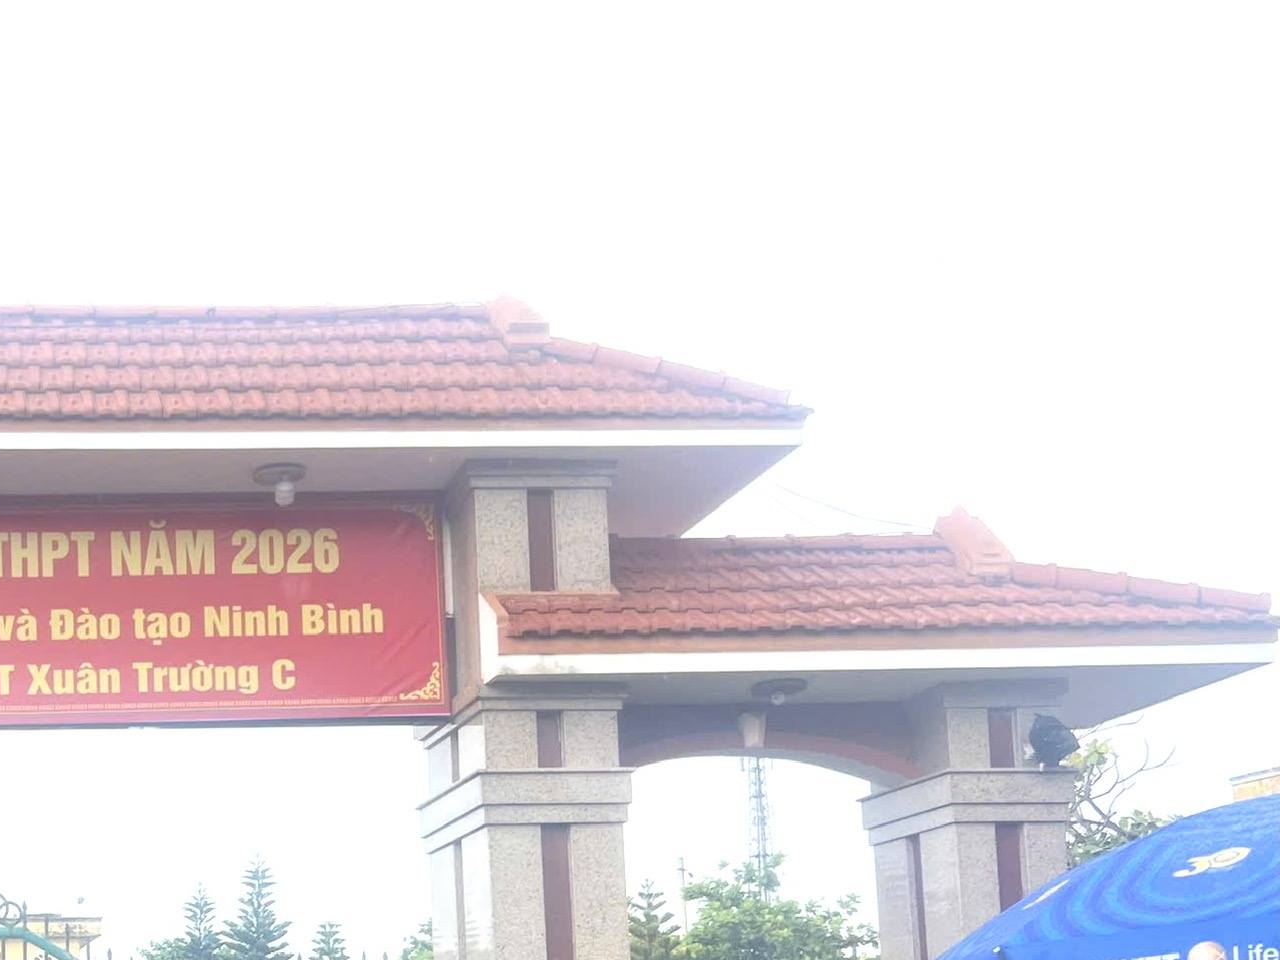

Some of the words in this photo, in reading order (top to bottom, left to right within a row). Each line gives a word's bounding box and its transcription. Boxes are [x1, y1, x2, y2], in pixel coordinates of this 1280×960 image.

[110, 519, 216, 577] NĂM
[231, 528, 340, 575] 2026
[49, 606, 121, 642] Đào
[132, 607, 192, 646] tạo
[203, 604, 290, 638] Ninh
[300, 602, 385, 637] Bình
[27, 661, 121, 696] Xuân
[132, 659, 261, 694] Trường
[271, 658, 298, 691] C
